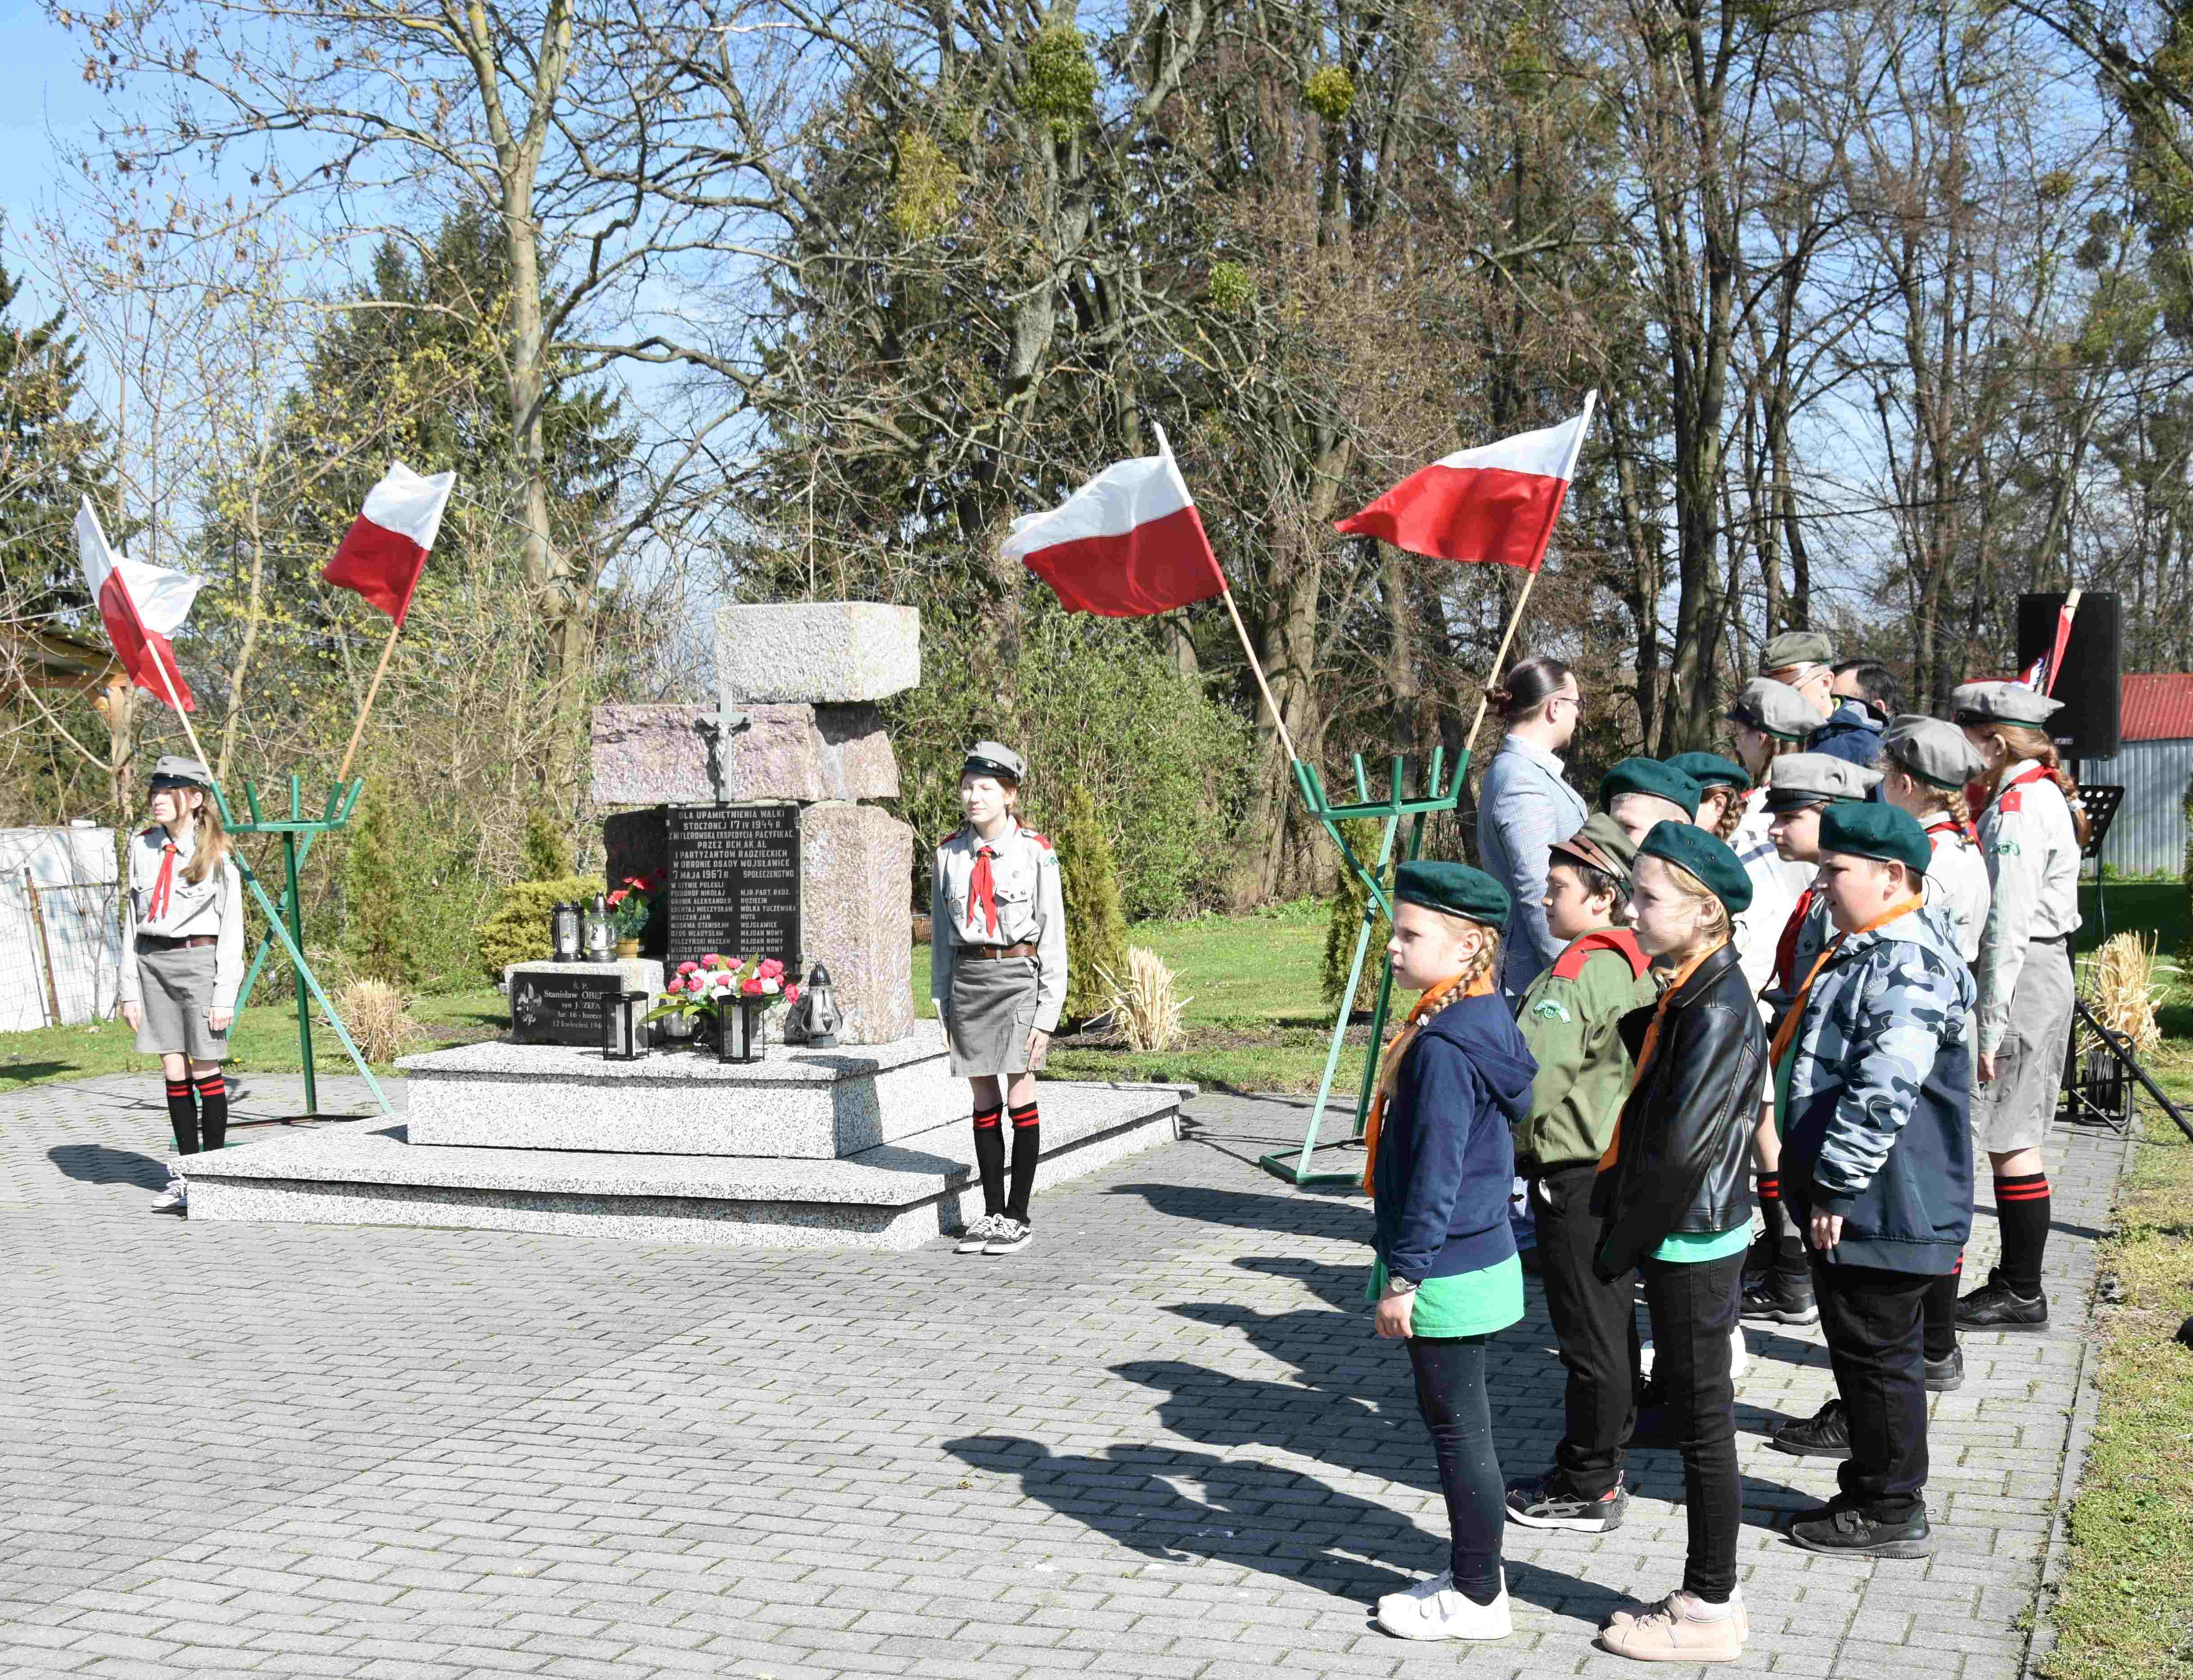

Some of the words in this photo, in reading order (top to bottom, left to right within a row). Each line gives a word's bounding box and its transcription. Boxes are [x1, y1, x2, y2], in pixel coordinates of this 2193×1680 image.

[760, 810, 784, 818] WALKI
[683, 822, 726, 830] STOCZONEJ
[731, 820, 740, 829] 17
[752, 820, 773, 829] 1944
[697, 841, 722, 849] PRZEZ
[739, 850, 787, 858] RADZIECKICH
[672, 870, 678, 879] 7
[703, 869, 722, 879] 1967
